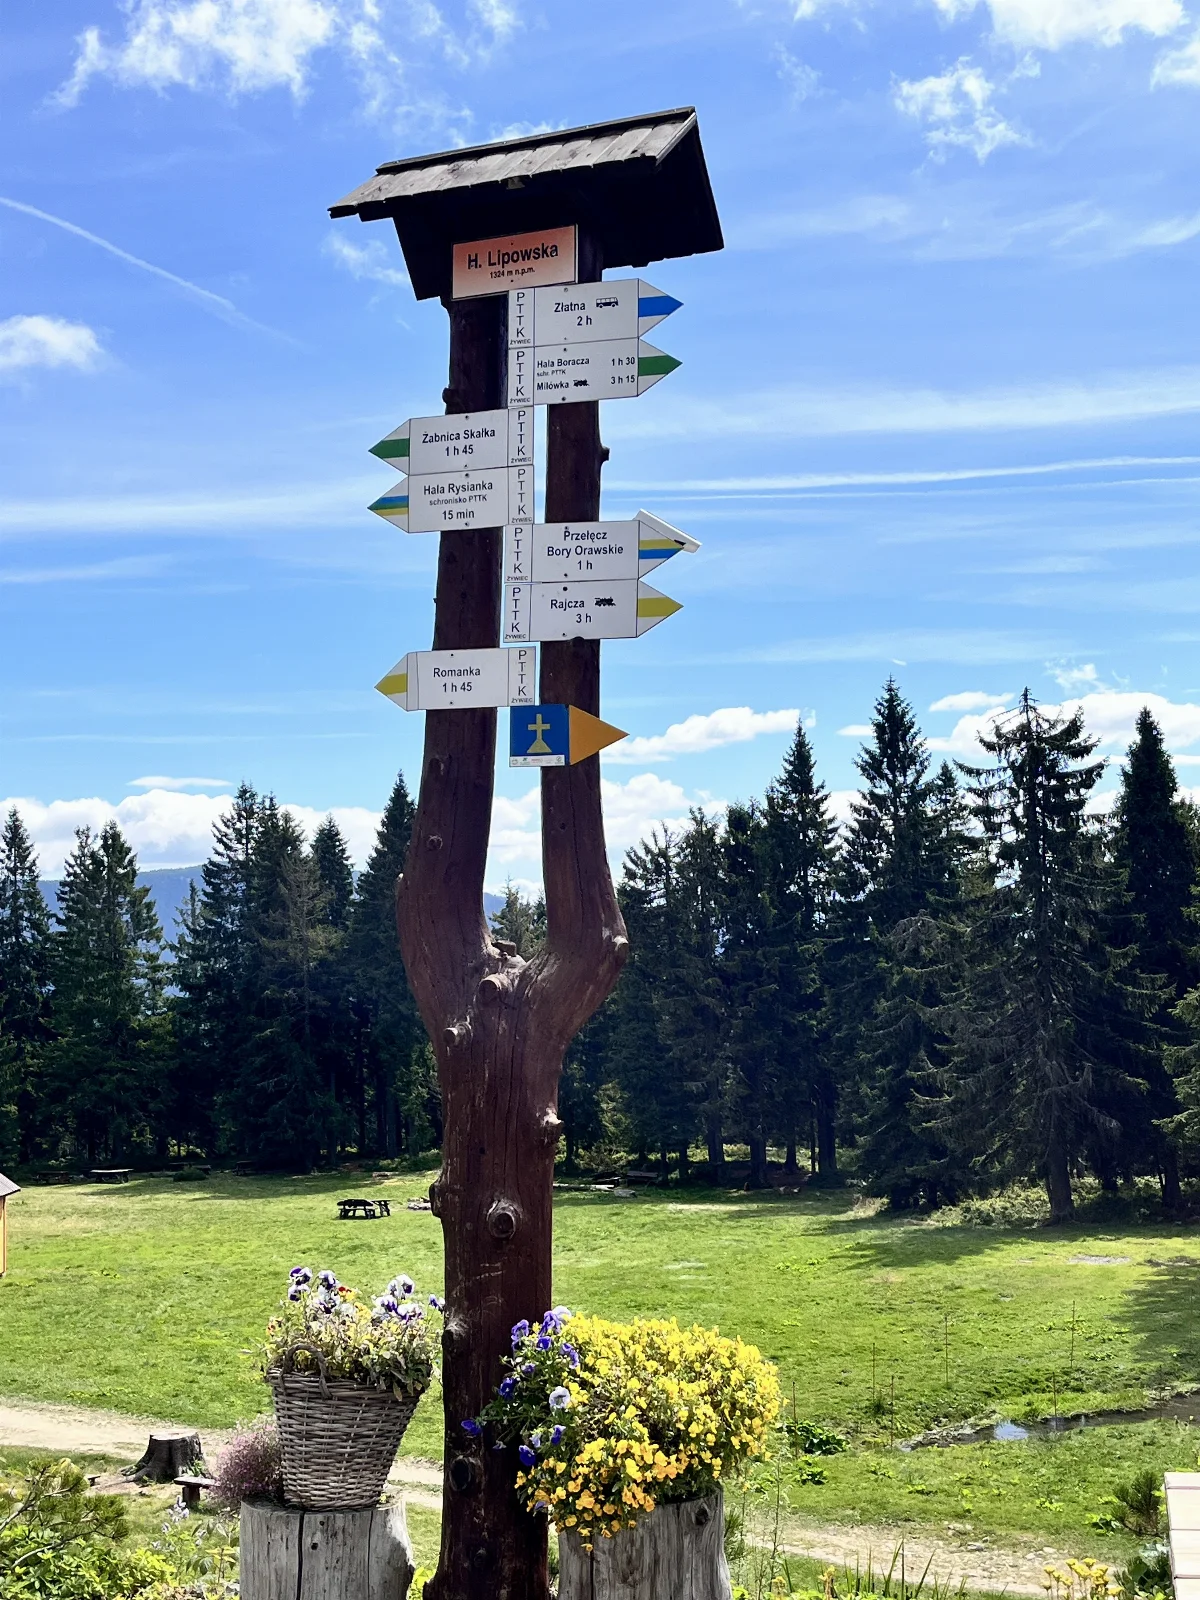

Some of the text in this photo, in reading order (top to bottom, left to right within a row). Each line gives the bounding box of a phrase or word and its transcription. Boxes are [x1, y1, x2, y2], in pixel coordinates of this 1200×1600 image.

[468, 243, 558, 269] H. Lipowska
[490, 270, 505, 278] 1324
[515, 267, 535, 276] n.p.m.
[554, 302, 586, 312] Złatna
[577, 316, 592, 326] 2 h
[537, 357, 589, 368] Hala Boracza
[618, 358, 623, 366] h
[625, 357, 635, 365] 30
[618, 376, 623, 384] h
[625, 375, 635, 383] 15
[422, 428, 495, 443] Żabnica Skałka
[453, 446, 459, 455] h
[462, 445, 473, 454] 45
[424, 481, 492, 495] Hala Rysianka
[429, 497, 467, 506] schronisko
[442, 509, 474, 520] 15 min
[564, 530, 607, 541] Przełęcz
[547, 544, 623, 558] Bory Orawskie
[586, 561, 592, 570] h
[550, 599, 584, 611] Rajcza
[576, 614, 591, 623] 3 h
[433, 667, 480, 677] Romanka
[451, 683, 457, 692] h
[460, 682, 472, 691] 45
